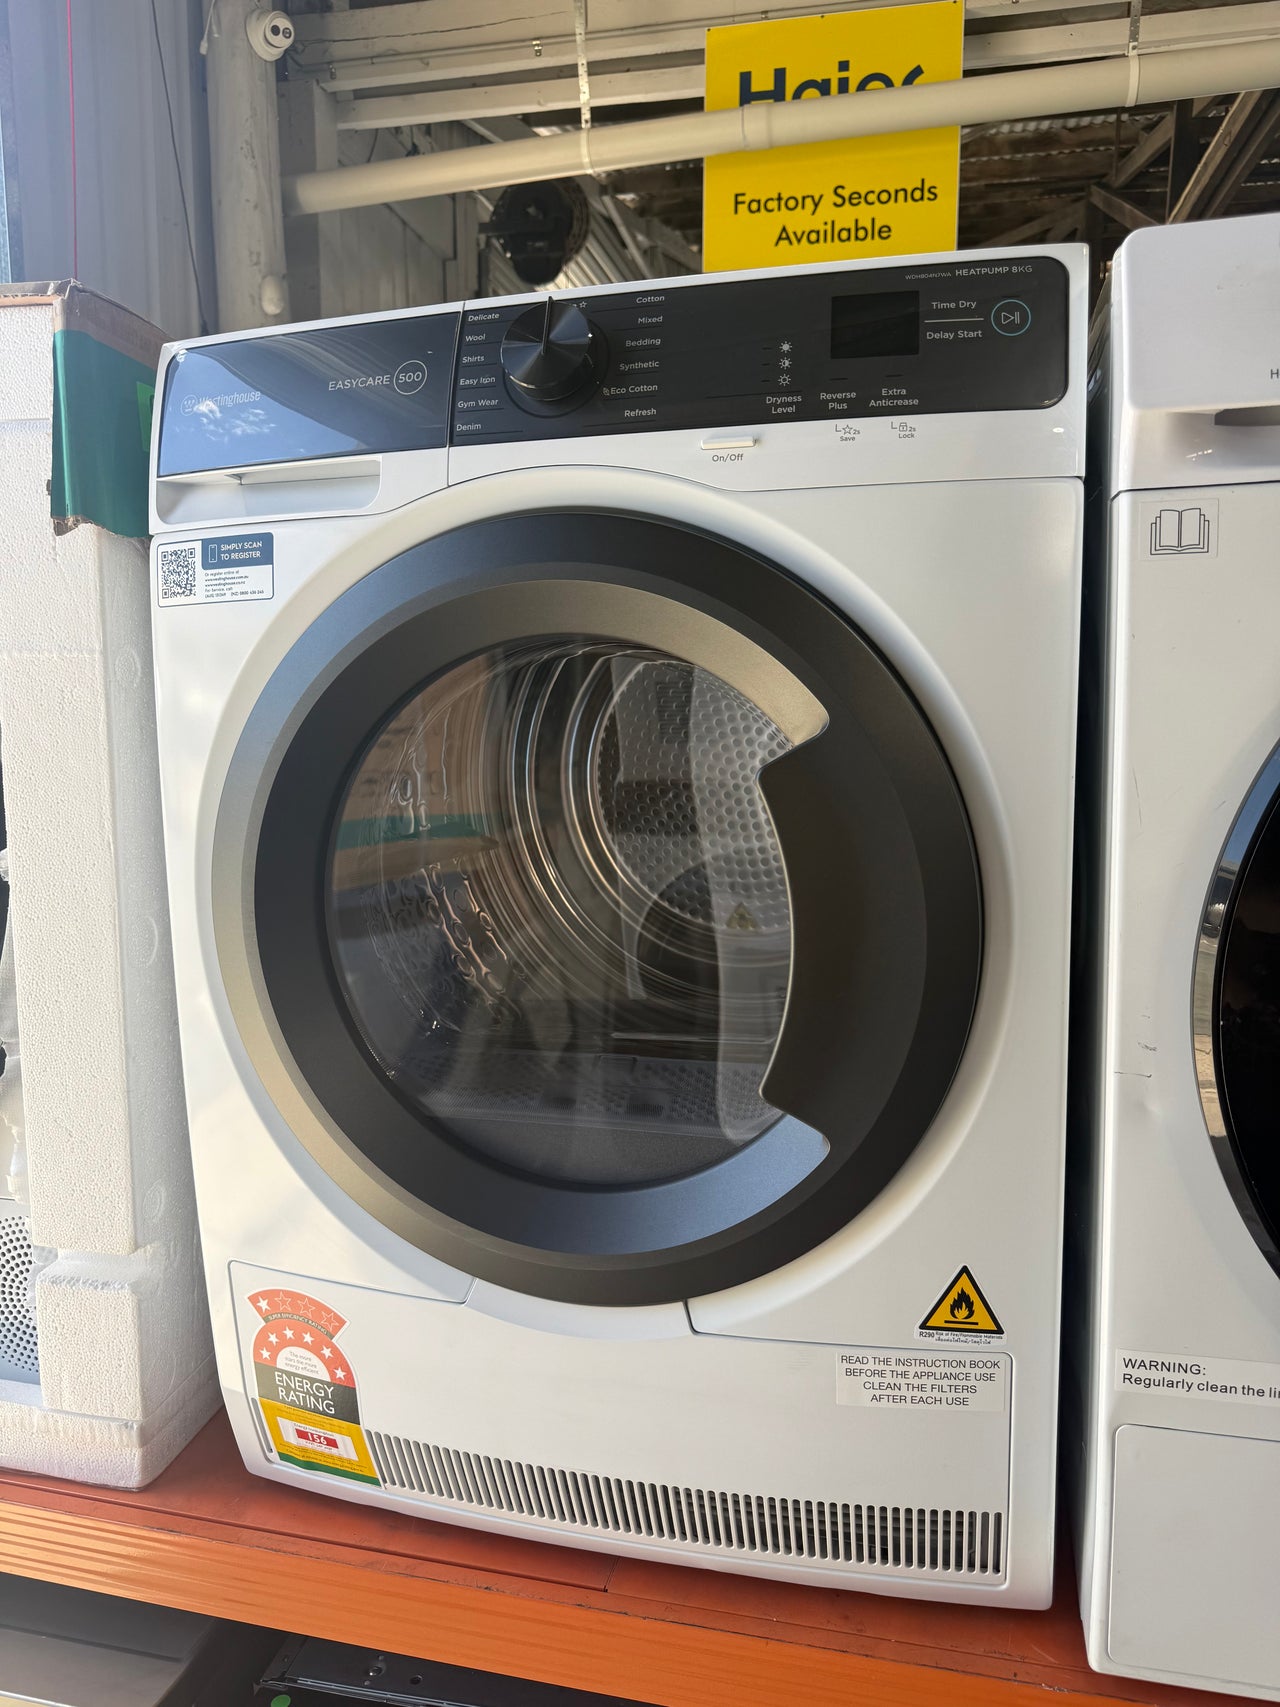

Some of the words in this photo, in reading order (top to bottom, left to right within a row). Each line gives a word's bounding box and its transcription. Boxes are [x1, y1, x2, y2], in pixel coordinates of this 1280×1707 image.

[733, 192, 823, 215] Factory
[833, 178, 938, 208] Seconds
[774, 217, 892, 247] Available
[955, 266, 1009, 277] HEATPUMP
[1011, 265, 1033, 273] 8KG
[636, 295, 665, 304] Cotton
[931, 301, 956, 309] Time
[959, 300, 977, 309] Dry
[468, 312, 500, 322] Delicate
[638, 316, 663, 324] Mixed
[465, 334, 486, 342] Wool
[926, 330, 955, 340] Delay
[957, 329, 982, 338] Start
[625, 337, 661, 348] Bedding
[462, 354, 485, 363] Shirts
[619, 360, 660, 371] Synthetic
[328, 374, 391, 391] EASYCARE
[398, 371, 423, 383] 500
[459, 378, 478, 387] Easy
[480, 376, 496, 384] Iron
[610, 387, 627, 395] Eco
[628, 384, 658, 393] Cotton
[820, 390, 857, 400] Reverse
[881, 387, 907, 396] Extra
[457, 400, 476, 409] Gym
[478, 398, 499, 407] Wear
[766, 394, 802, 405] Dryness
[869, 397, 919, 407] Anticrease
[771, 405, 796, 414] Level
[828, 402, 848, 410] Plus
[624, 408, 657, 417] Refresh
[456, 423, 482, 431] Denim
[711, 453, 744, 463] On/Off
[221, 543, 243, 551] SIMPLY
[221, 553, 230, 561] TO
[230, 551, 261, 560] REGISTER
[841, 1355, 869, 1365] READ
[871, 1356, 892, 1366] THE
[895, 1358, 967, 1369] INSTRUCTION
[969, 1360, 1000, 1369] BOOK
[1122, 1357, 1206, 1376] WARNING:
[845, 1368, 887, 1378] BEFORE
[889, 1370, 910, 1379] THE
[912, 1371, 971, 1381] APPLIANCE
[974, 1372, 996, 1381] USE
[274, 1371, 334, 1399] ENERGY
[863, 1381, 902, 1391] CLEAN
[904, 1383, 928, 1392] THE
[930, 1384, 977, 1393] FILTERS
[1122, 1373, 1194, 1392] Regularly
[1197, 1381, 1238, 1394] clean
[1242, 1385, 1265, 1397] the
[1269, 1387, 1280, 1399] li
[278, 1386, 335, 1414] RATING
[870, 1394, 907, 1404] AFTER
[910, 1395, 942, 1405] EACH
[945, 1396, 969, 1406] USE
[307, 1432, 327, 1445] 156
